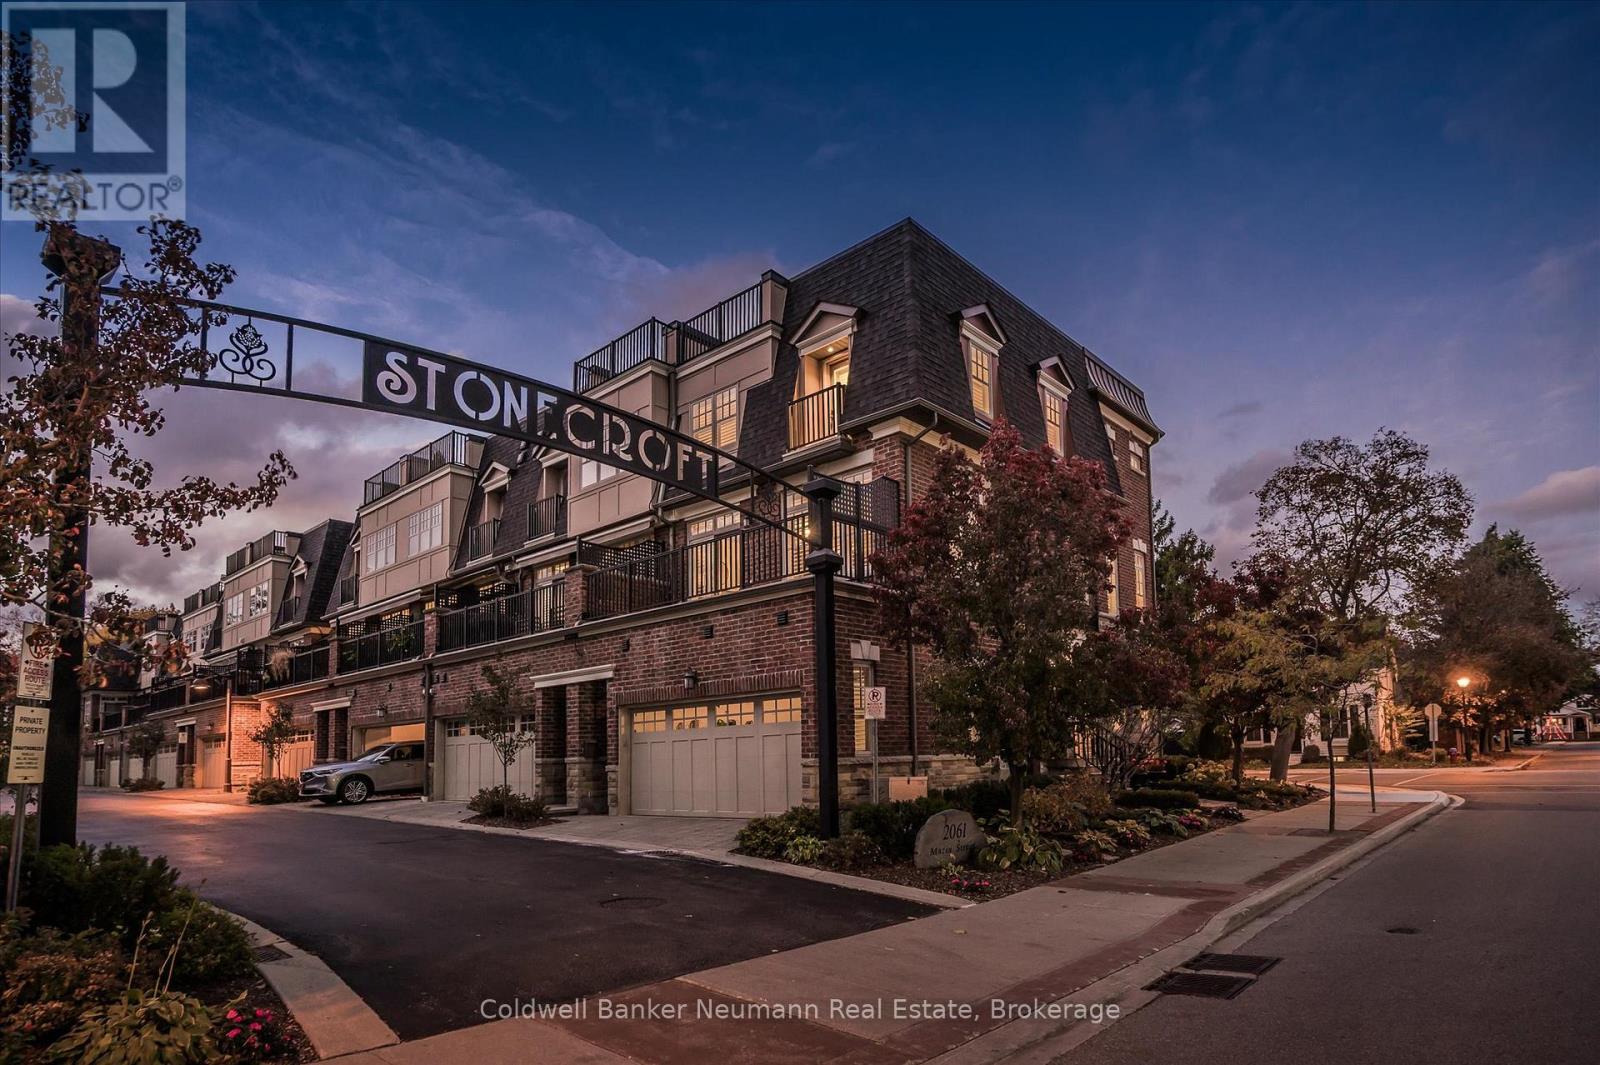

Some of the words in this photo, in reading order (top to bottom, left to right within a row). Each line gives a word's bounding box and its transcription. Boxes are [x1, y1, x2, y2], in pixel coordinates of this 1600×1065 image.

[376, 351, 713, 490] STONECROFT
[28, 659, 44, 667] FIRE
[23, 667, 49, 676] ACCESS
[24, 675, 46, 685] ROUTE
[19, 716, 44, 725] PRIVATE
[15, 726, 46, 735] PROPERTY
[943, 822, 967, 841] 2061
